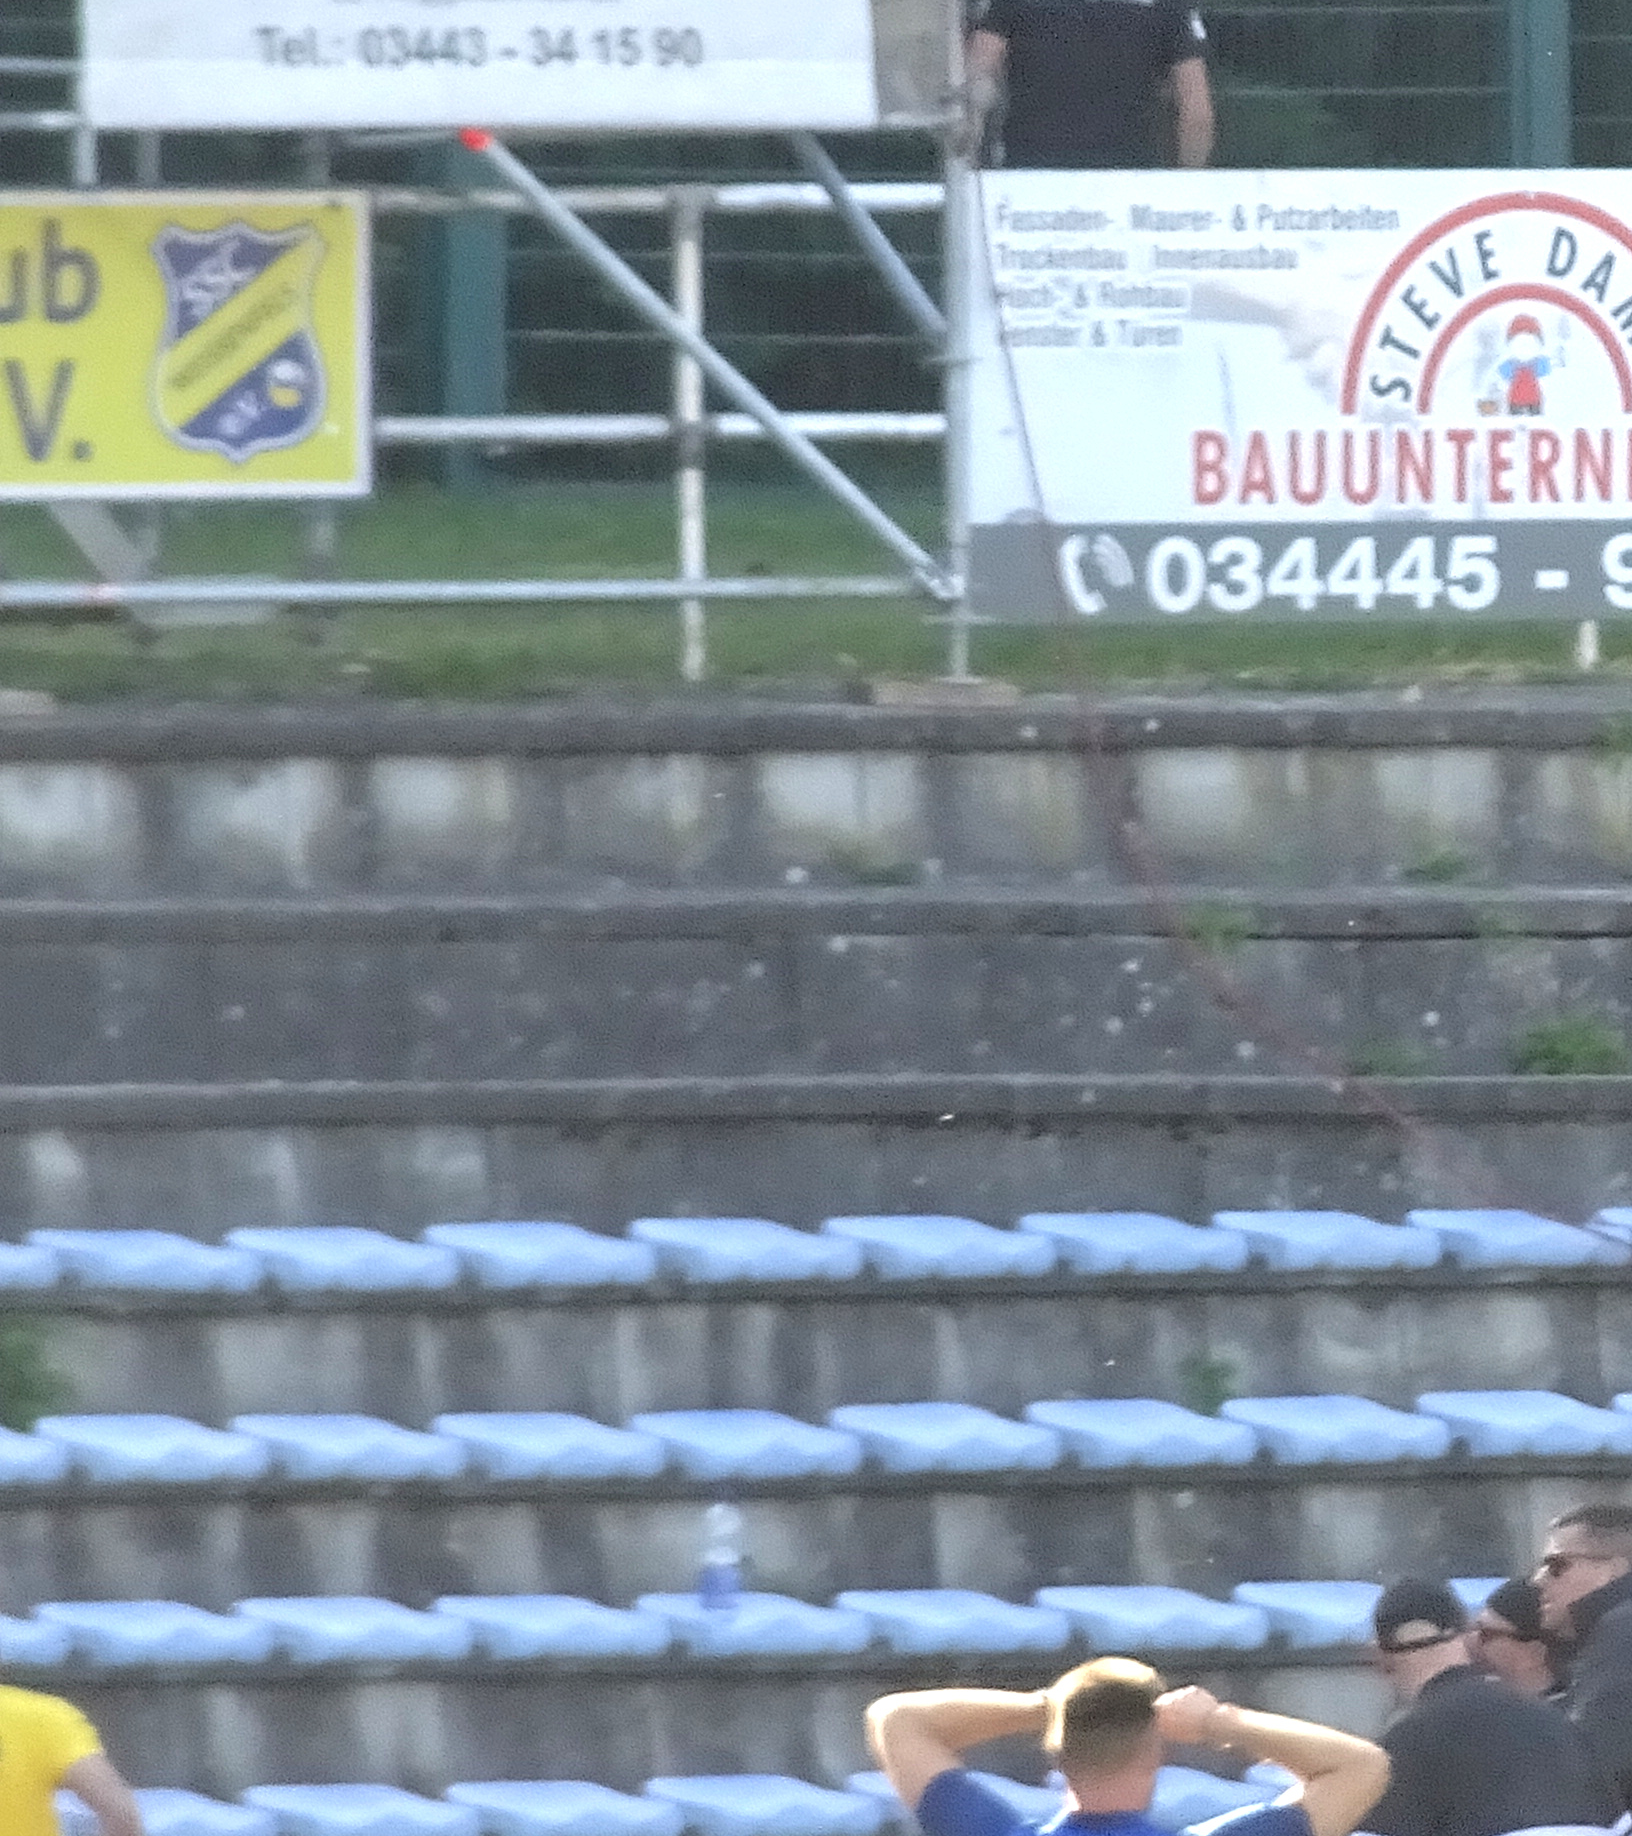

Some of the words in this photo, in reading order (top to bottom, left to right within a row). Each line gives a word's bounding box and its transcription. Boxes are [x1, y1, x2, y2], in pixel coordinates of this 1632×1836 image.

[255, 24, 346, 67] Tel.:
[356, 26, 489, 69] 03443
[529, 26, 578, 68] 34
[592, 26, 642, 67] 15
[652, 25, 704, 68] 90
[1368, 228, 1500, 404] STEVE
[1145, 534, 1501, 613] 034445
